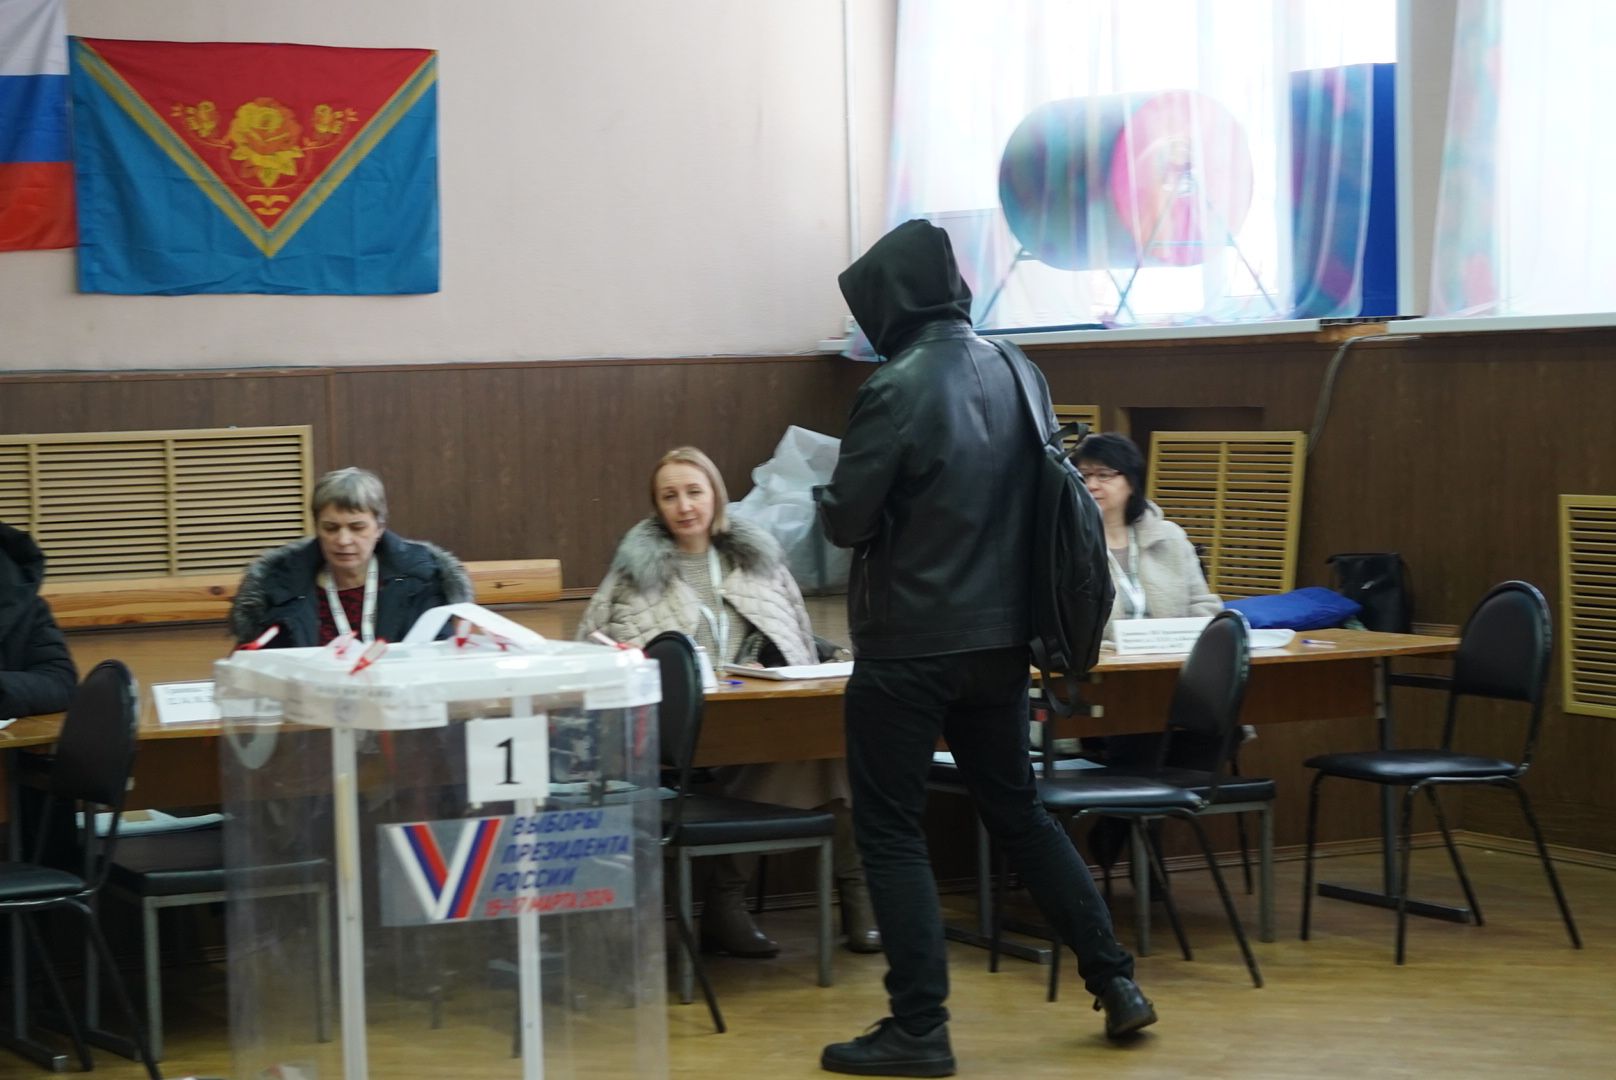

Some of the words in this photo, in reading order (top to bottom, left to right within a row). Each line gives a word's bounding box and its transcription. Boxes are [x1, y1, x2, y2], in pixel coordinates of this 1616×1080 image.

[495, 736, 521, 785] 1
[512, 810, 603, 836] ВЫБОРЫ
[503, 835, 629, 864] ПРЕЗИДЕНТА
[493, 867, 576, 892] РОССИИ
